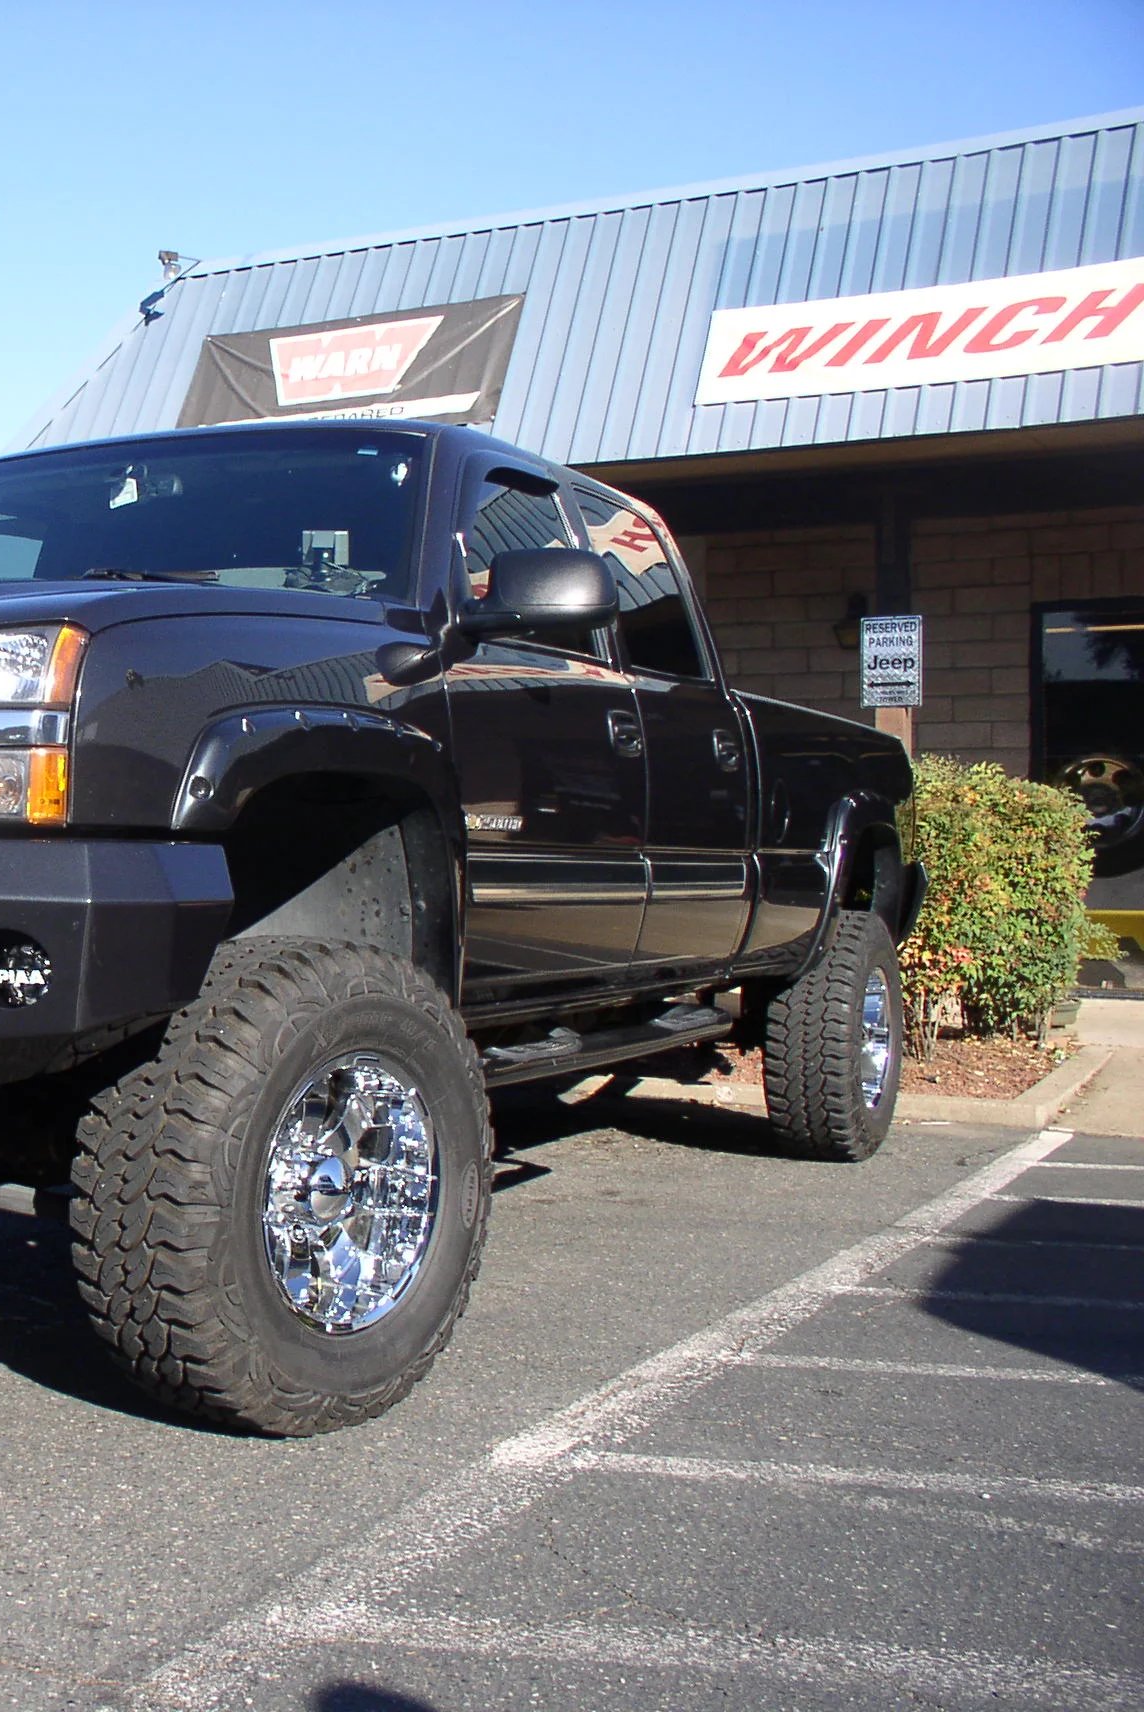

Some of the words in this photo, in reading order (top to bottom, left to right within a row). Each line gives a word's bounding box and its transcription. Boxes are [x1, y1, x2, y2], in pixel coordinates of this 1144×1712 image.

[717, 282, 1144, 378] WINCH
[289, 344, 402, 383] WARN
[865, 621, 917, 634] RESERVED
[868, 636, 914, 648] PARKING
[867, 655, 915, 673] Jeep
